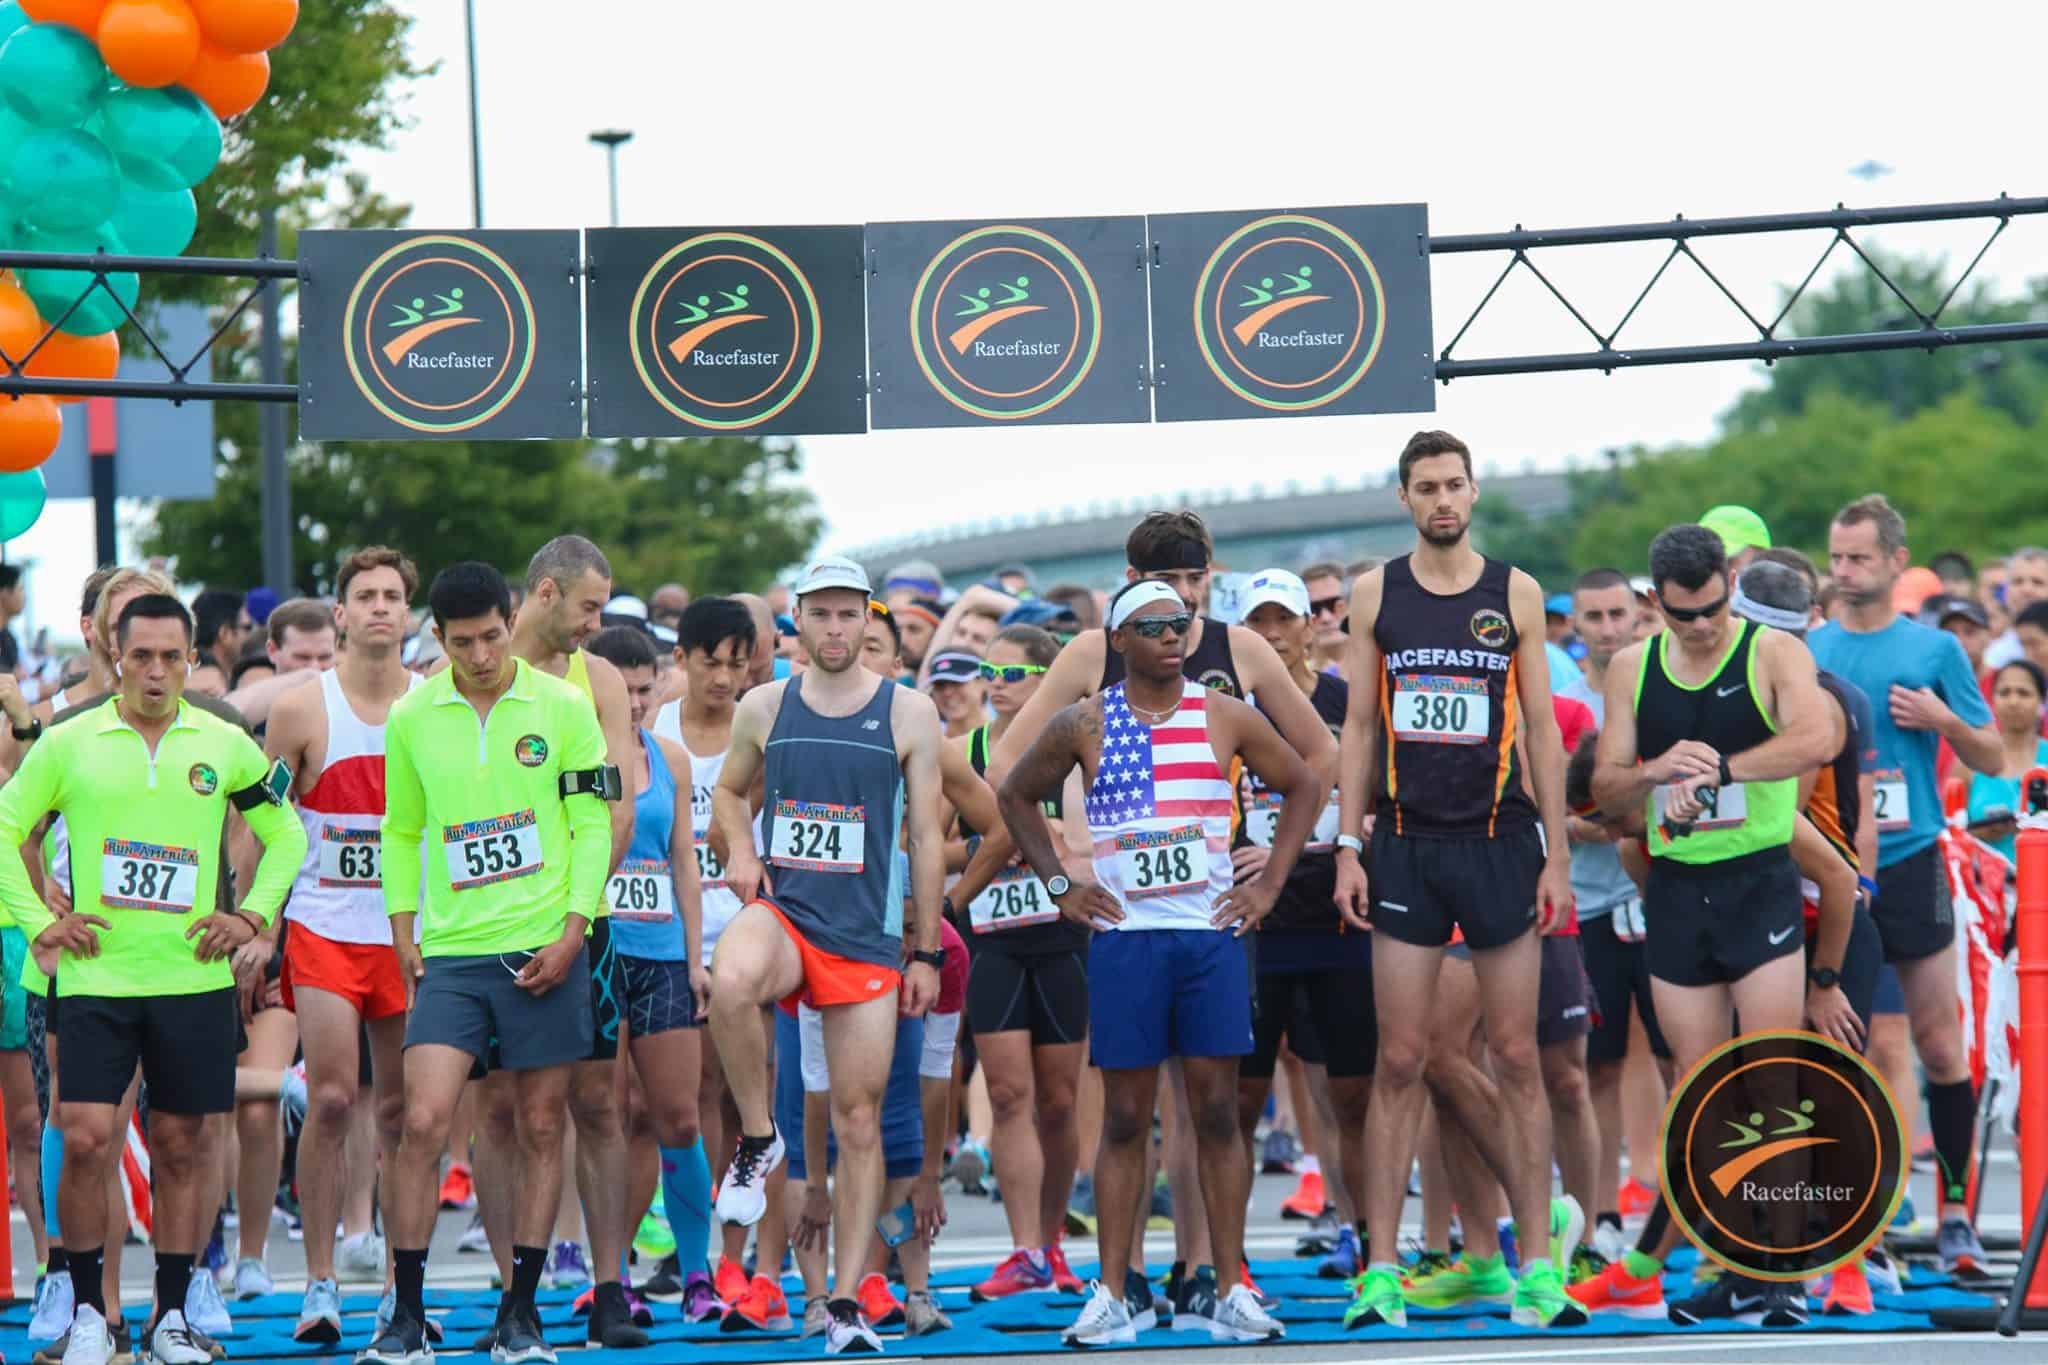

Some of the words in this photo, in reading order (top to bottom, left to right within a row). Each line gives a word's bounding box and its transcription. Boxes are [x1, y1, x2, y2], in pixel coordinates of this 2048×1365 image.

[975, 339, 1061, 358] Racefaster
[1258, 329, 1345, 348] Racefaster
[407, 351, 495, 369] Racefaster
[693, 348, 780, 366] Racefaster
[1411, 694, 1468, 732] 380
[805, 805, 860, 820] AMERICA
[464, 833, 522, 877] 553
[788, 820, 842, 861] 324
[339, 845, 381, 879] 63
[1135, 846, 1192, 888] 348
[118, 860, 178, 901] 387
[613, 877, 658, 910] 269
[989, 881, 1040, 919] 264
